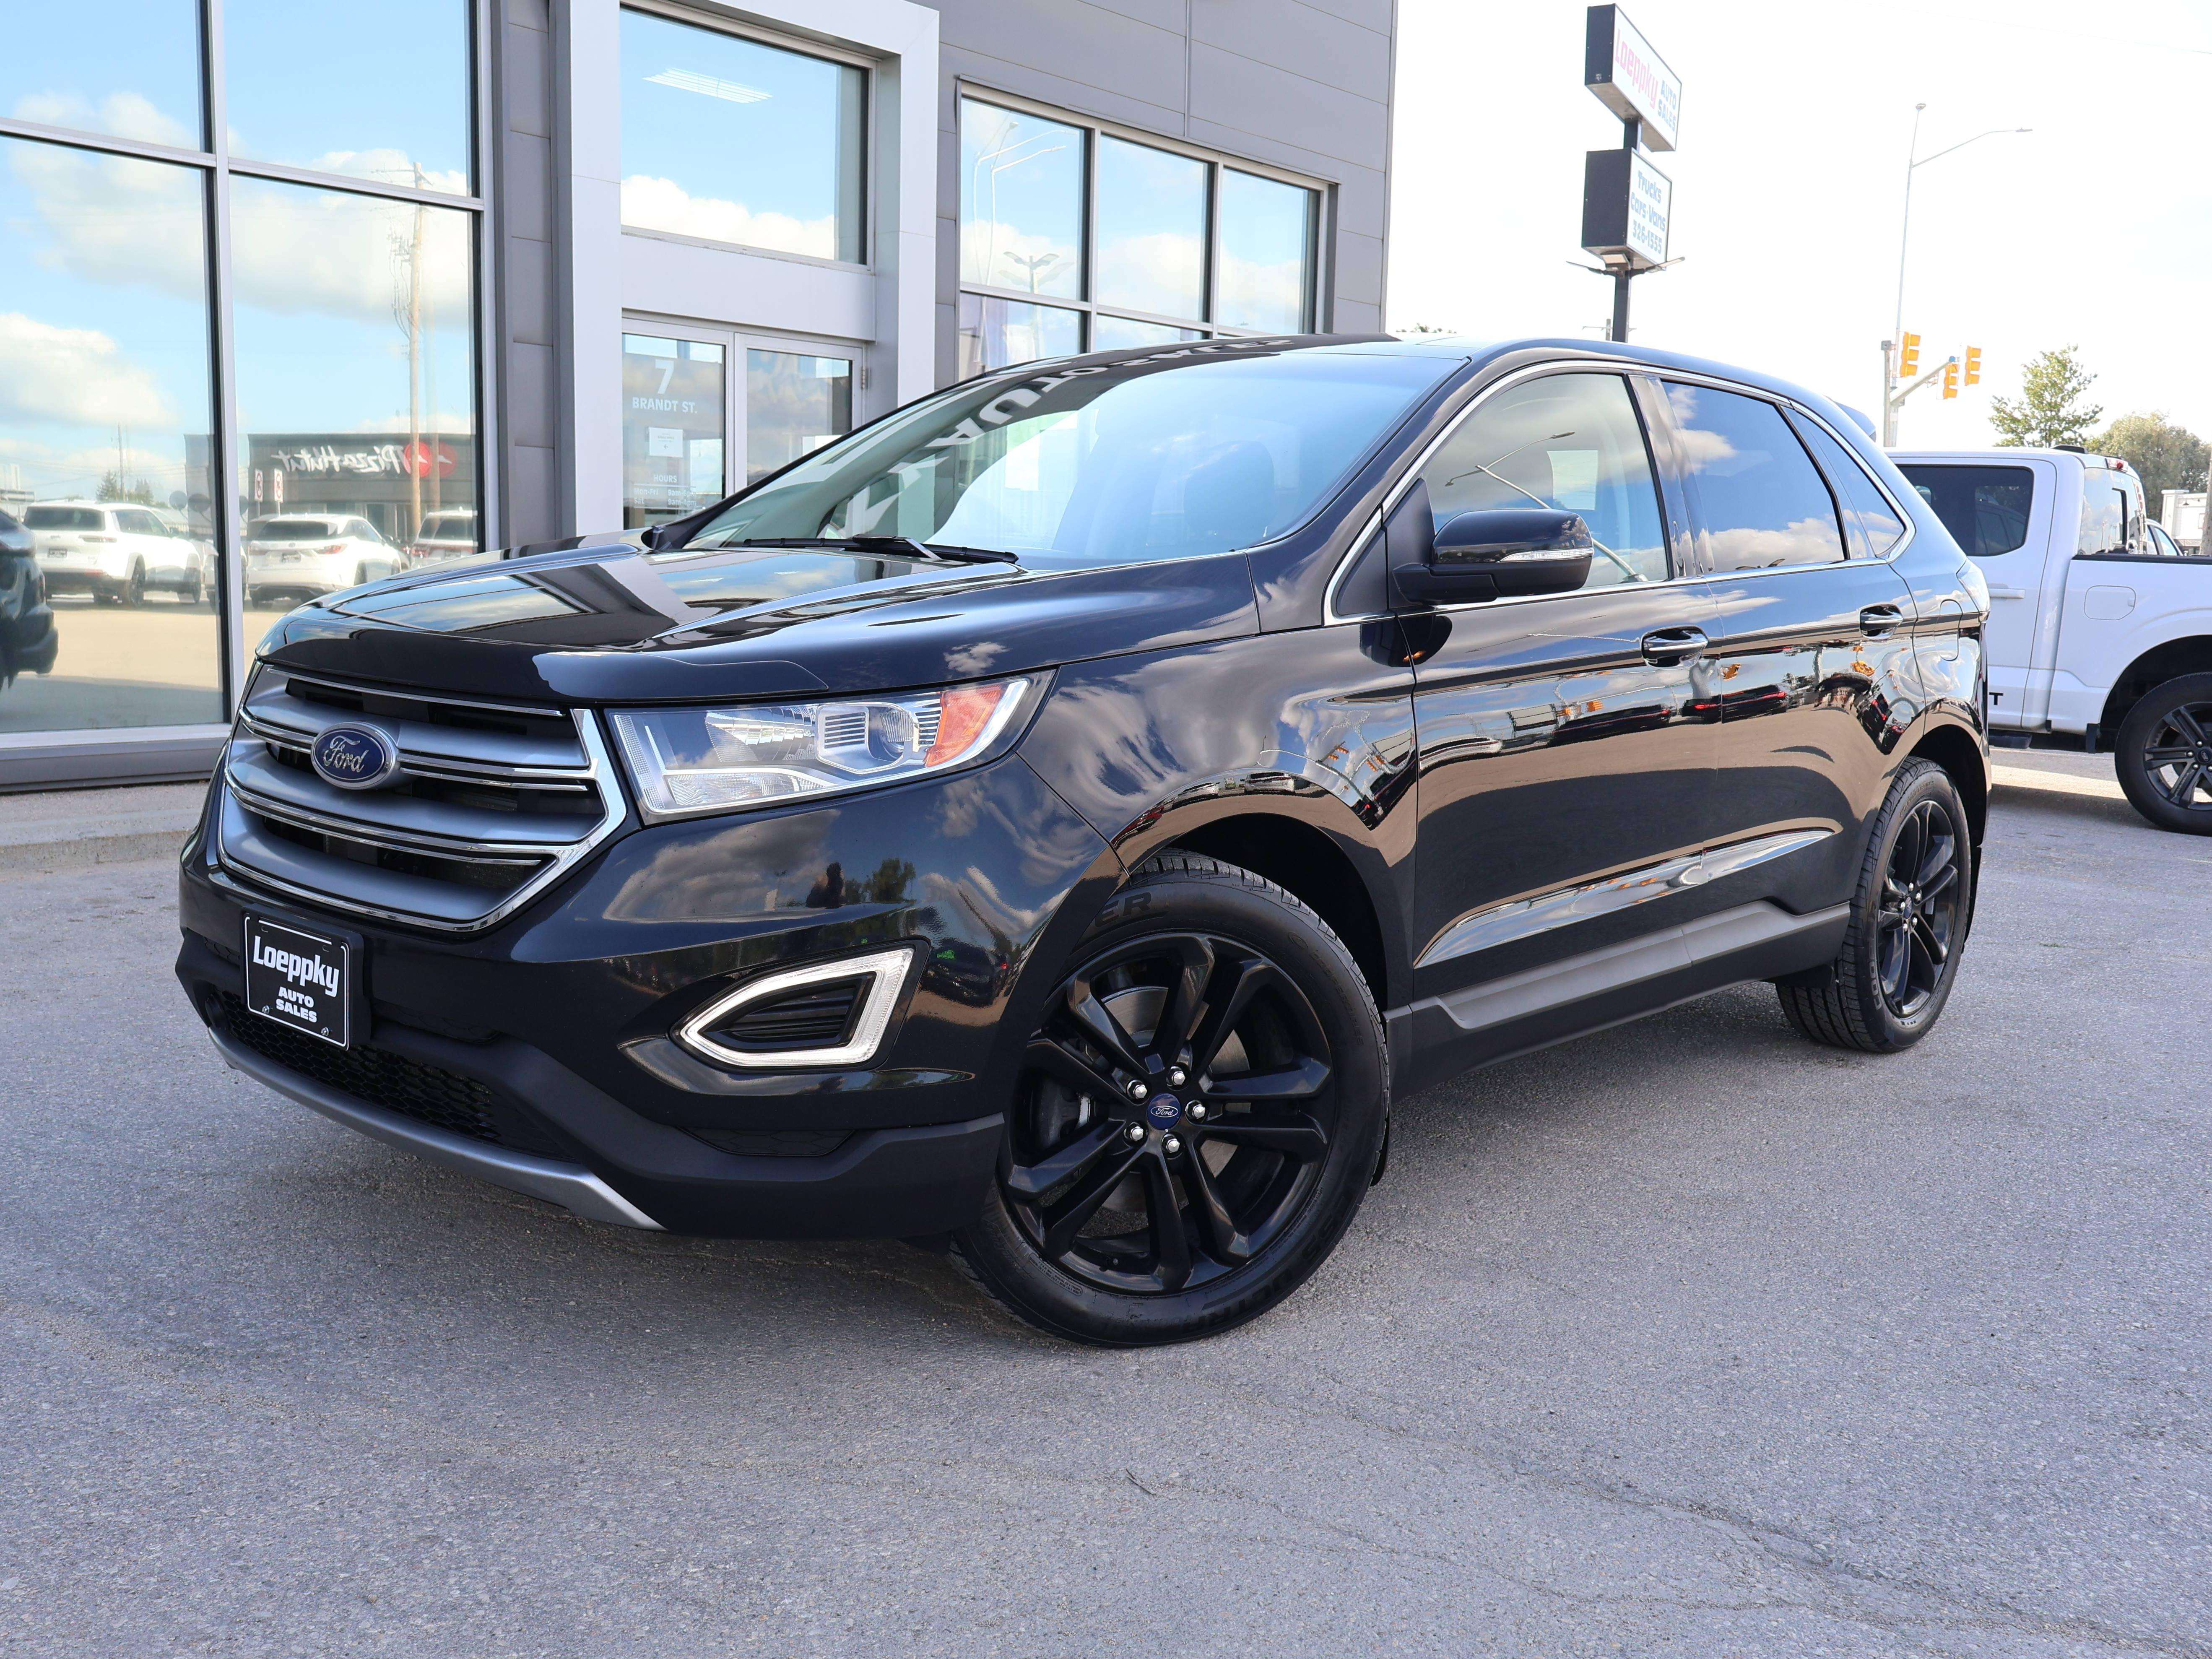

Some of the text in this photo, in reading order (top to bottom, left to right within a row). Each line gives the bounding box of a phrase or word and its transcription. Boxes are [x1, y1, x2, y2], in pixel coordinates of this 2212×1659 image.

[1615, 28, 1658, 109] Loeppky
[1661, 79, 1677, 110] AUTO
[1658, 99, 1677, 132] SALES
[1638, 170, 1662, 203] Trucks
[1633, 219, 1662, 254] 326-1555
[655, 359, 674, 394] 7
[632, 397, 698, 413] BRANDT ST.
[654, 474, 678, 483] HOURS
[323, 735, 369, 773] Ford
[252, 935, 340, 998] Loeppky
[276, 999, 317, 1023] SALES
[278, 986, 314, 1008] AUTO
[1155, 1107, 1174, 1116] Ford
